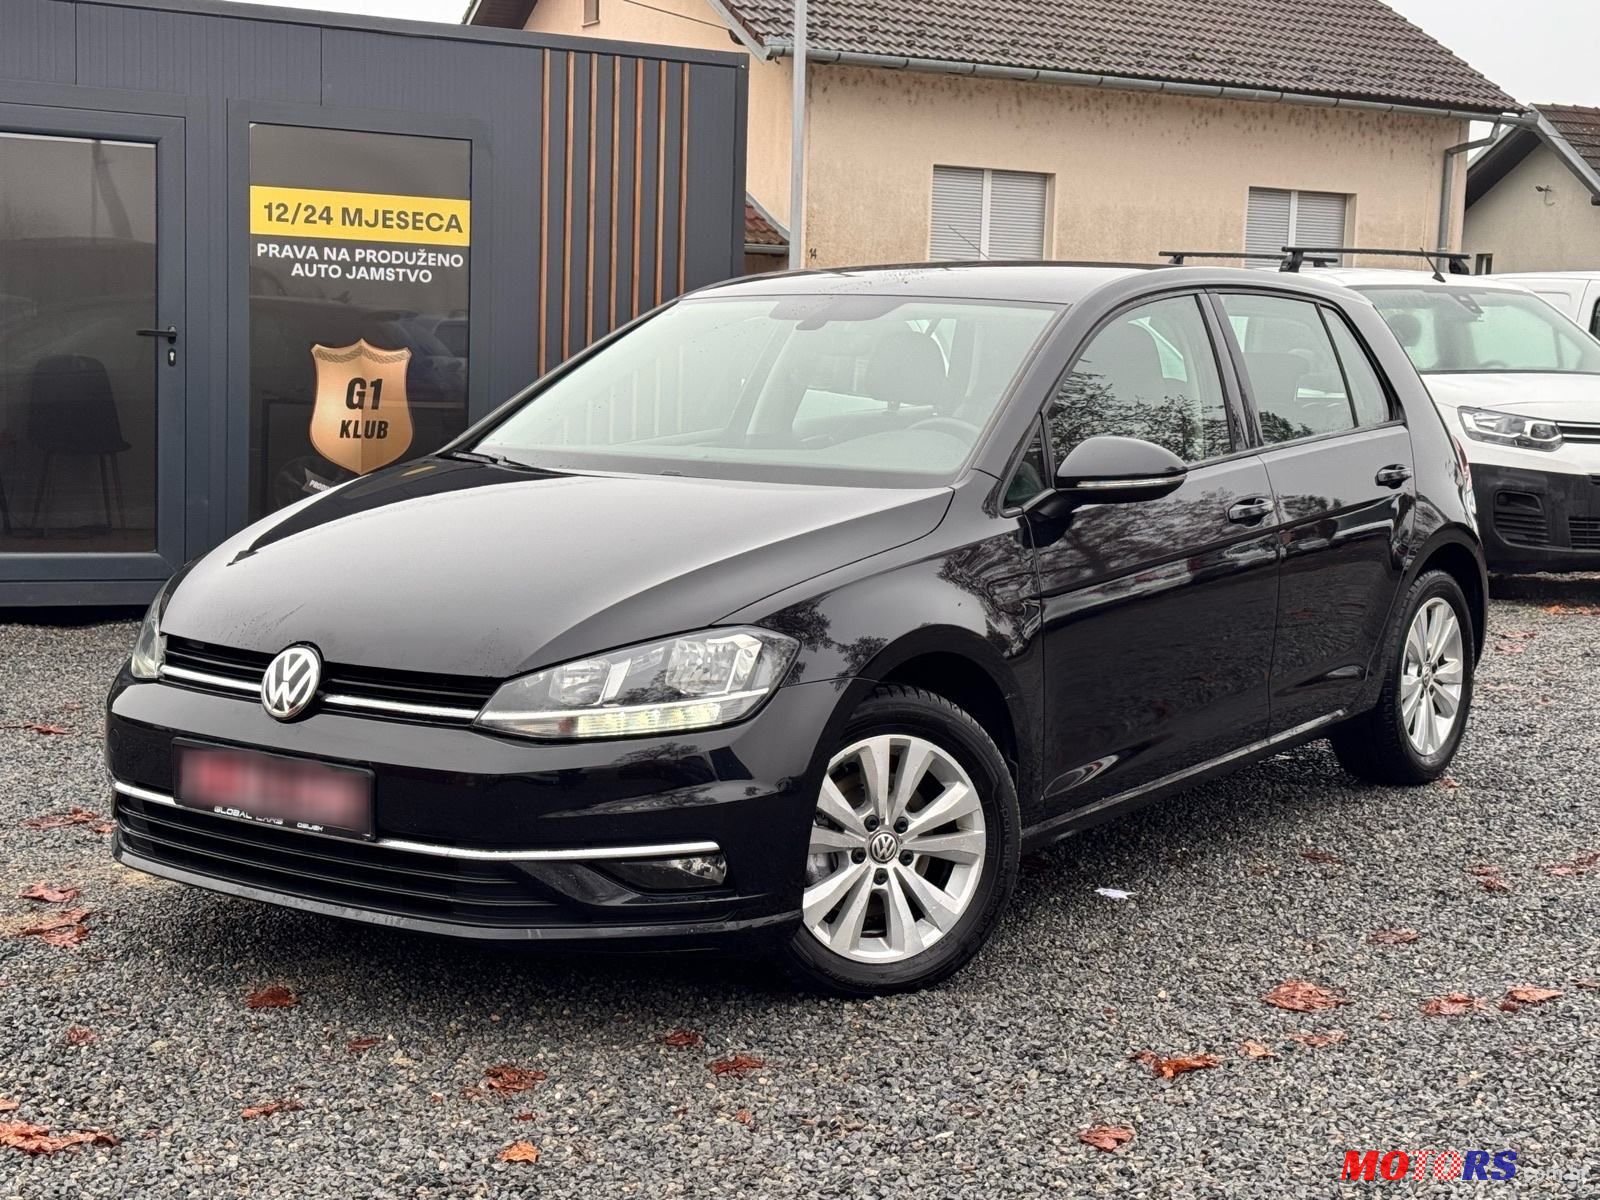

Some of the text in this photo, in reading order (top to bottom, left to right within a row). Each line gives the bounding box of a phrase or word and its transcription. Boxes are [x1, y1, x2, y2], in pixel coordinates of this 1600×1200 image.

[263, 202, 463, 233] 12/24 MJESECA
[256, 243, 464, 268] PRAVA NA PRODUŽENO
[291, 263, 433, 283] AUTO JAMSTVO
[345, 377, 383, 411] G1
[339, 419, 389, 439] KLUB
[213, 805, 253, 820] GLOBAL
